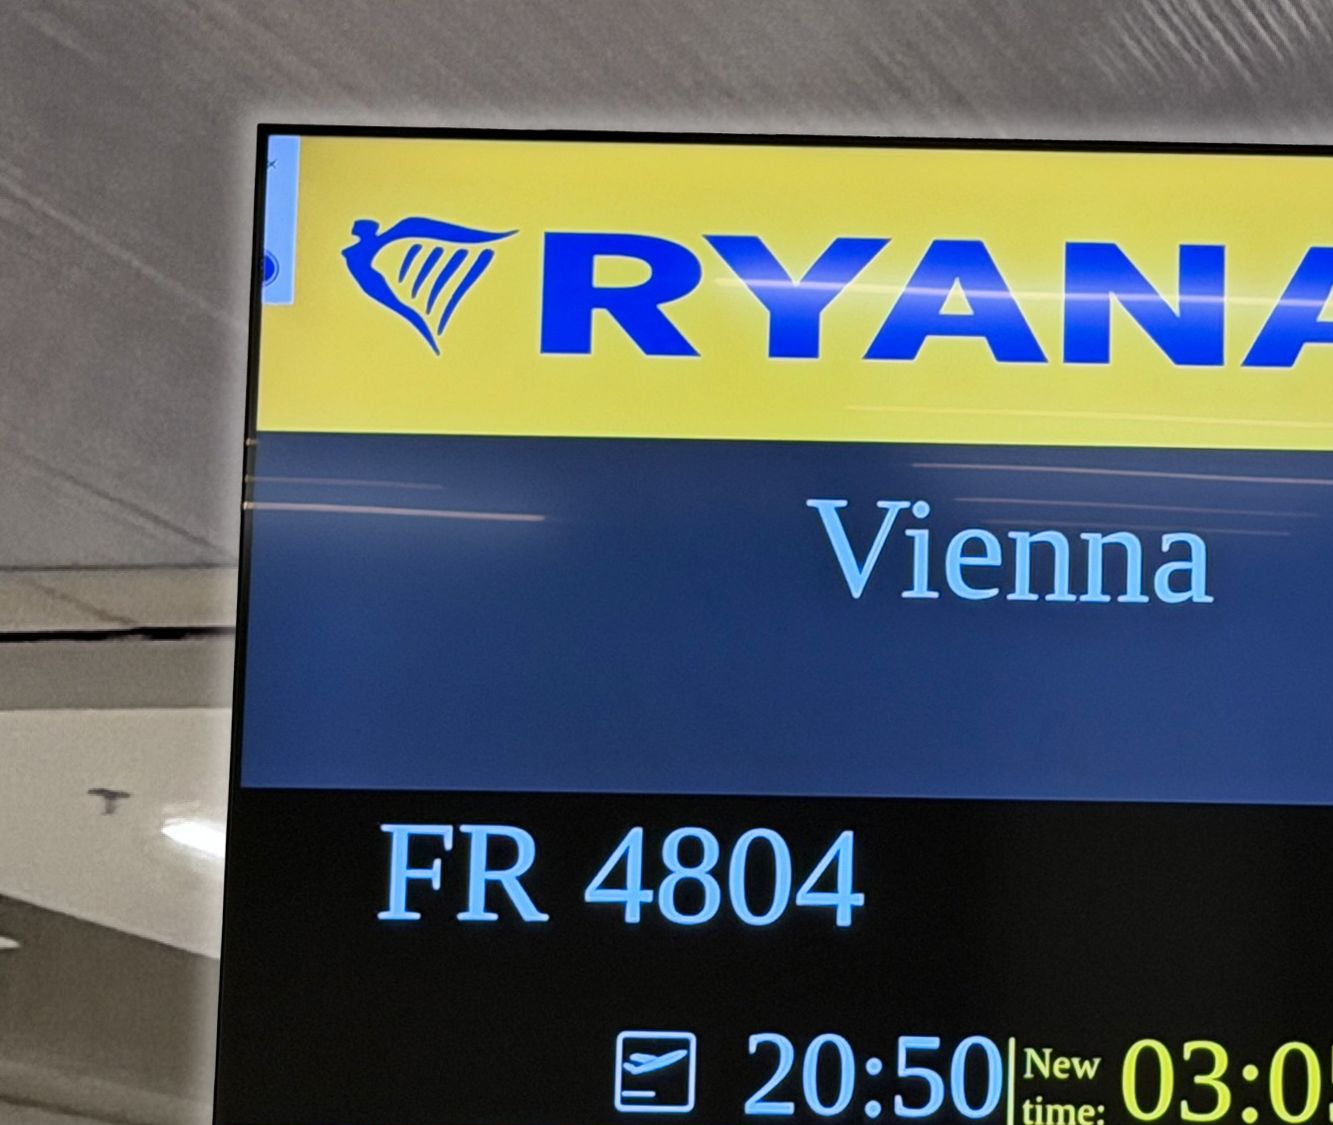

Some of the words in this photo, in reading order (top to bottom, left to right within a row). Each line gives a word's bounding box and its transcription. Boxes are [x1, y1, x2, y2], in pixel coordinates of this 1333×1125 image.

[806, 498, 1214, 604] Vienna
[377, 823, 549, 923] FR
[584, 826, 865, 928] 4804
[744, 1032, 1003, 1119] 20:50
[1023, 1047, 1101, 1080] New
